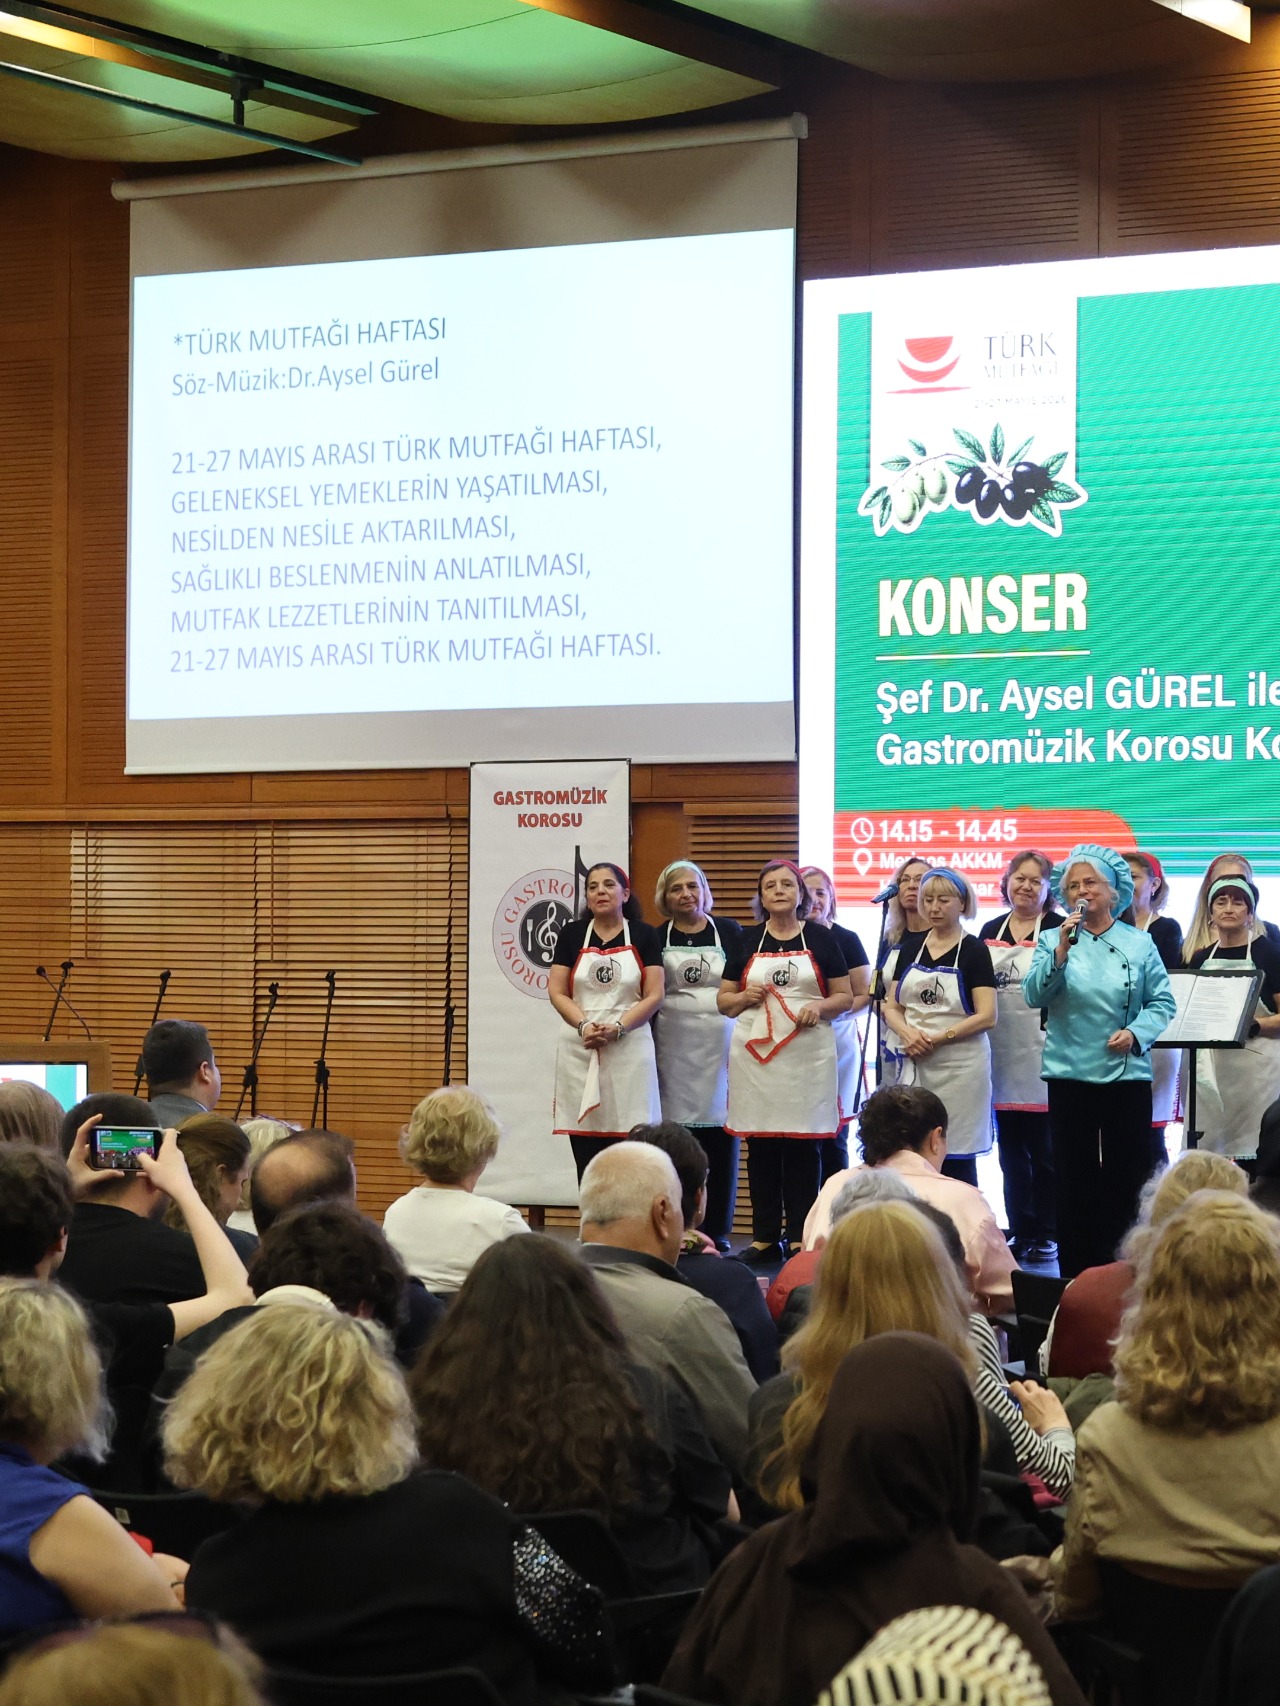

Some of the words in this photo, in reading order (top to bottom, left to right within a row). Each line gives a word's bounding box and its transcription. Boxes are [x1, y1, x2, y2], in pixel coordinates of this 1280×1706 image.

[249, 317, 349, 351] MUTFAĞI
[356, 316, 447, 345] HAFTASI
[983, 330, 1057, 360] TÜRK
[171, 360, 373, 397] Söz-Müzik:Dr.Aysel
[380, 355, 439, 383] Gürel
[171, 449, 231, 475] 21-27
[238, 445, 306, 471] MAYIS
[311, 441, 375, 467] ARASI
[382, 433, 442, 462] TÜRK
[449, 425, 553, 459] MUTFAĞI
[561, 425, 662, 453] HAFTASI,
[171, 485, 304, 514] GELENEKSEL
[309, 473, 449, 507] YEMEKLERİN
[456, 469, 608, 504] YAŞATILMASI,
[172, 524, 275, 554] NESİLDEN
[282, 518, 355, 548] NESİLE
[360, 514, 516, 543] AKTARILMASI,
[170, 562, 262, 594] SAĞLIKLI
[269, 554, 427, 588] BESLENMENİN
[433, 552, 591, 581] ANLATILMASI,
[171, 606, 261, 633] MUTFAK
[268, 594, 430, 629] LEZZETLERİNİN
[436, 593, 587, 621] TANITILMASI,
[877, 572, 1089, 638] KONSER
[170, 647, 230, 673] 21-27
[237, 644, 304, 670] MAYIS
[310, 642, 374, 668] ARASI
[381, 635, 441, 664] TÜRK
[448, 629, 552, 662] MUTFAĞI
[561, 632, 661, 659] HAFTASI.
[875, 679, 933, 725] Şef
[942, 680, 989, 714] Dr.
[999, 674, 1094, 720] Aysel
[1105, 667, 1236, 711] GÜREL
[875, 727, 1097, 766] Gastromüzik
[1106, 727, 1234, 763] Korosu
[493, 786, 608, 806] GASTROMÜZİK
[517, 812, 583, 828] KOROSU
[879, 819, 932, 842] 14.15
[956, 818, 1017, 842] 14.45
[949, 852, 1003, 869] AKKM
